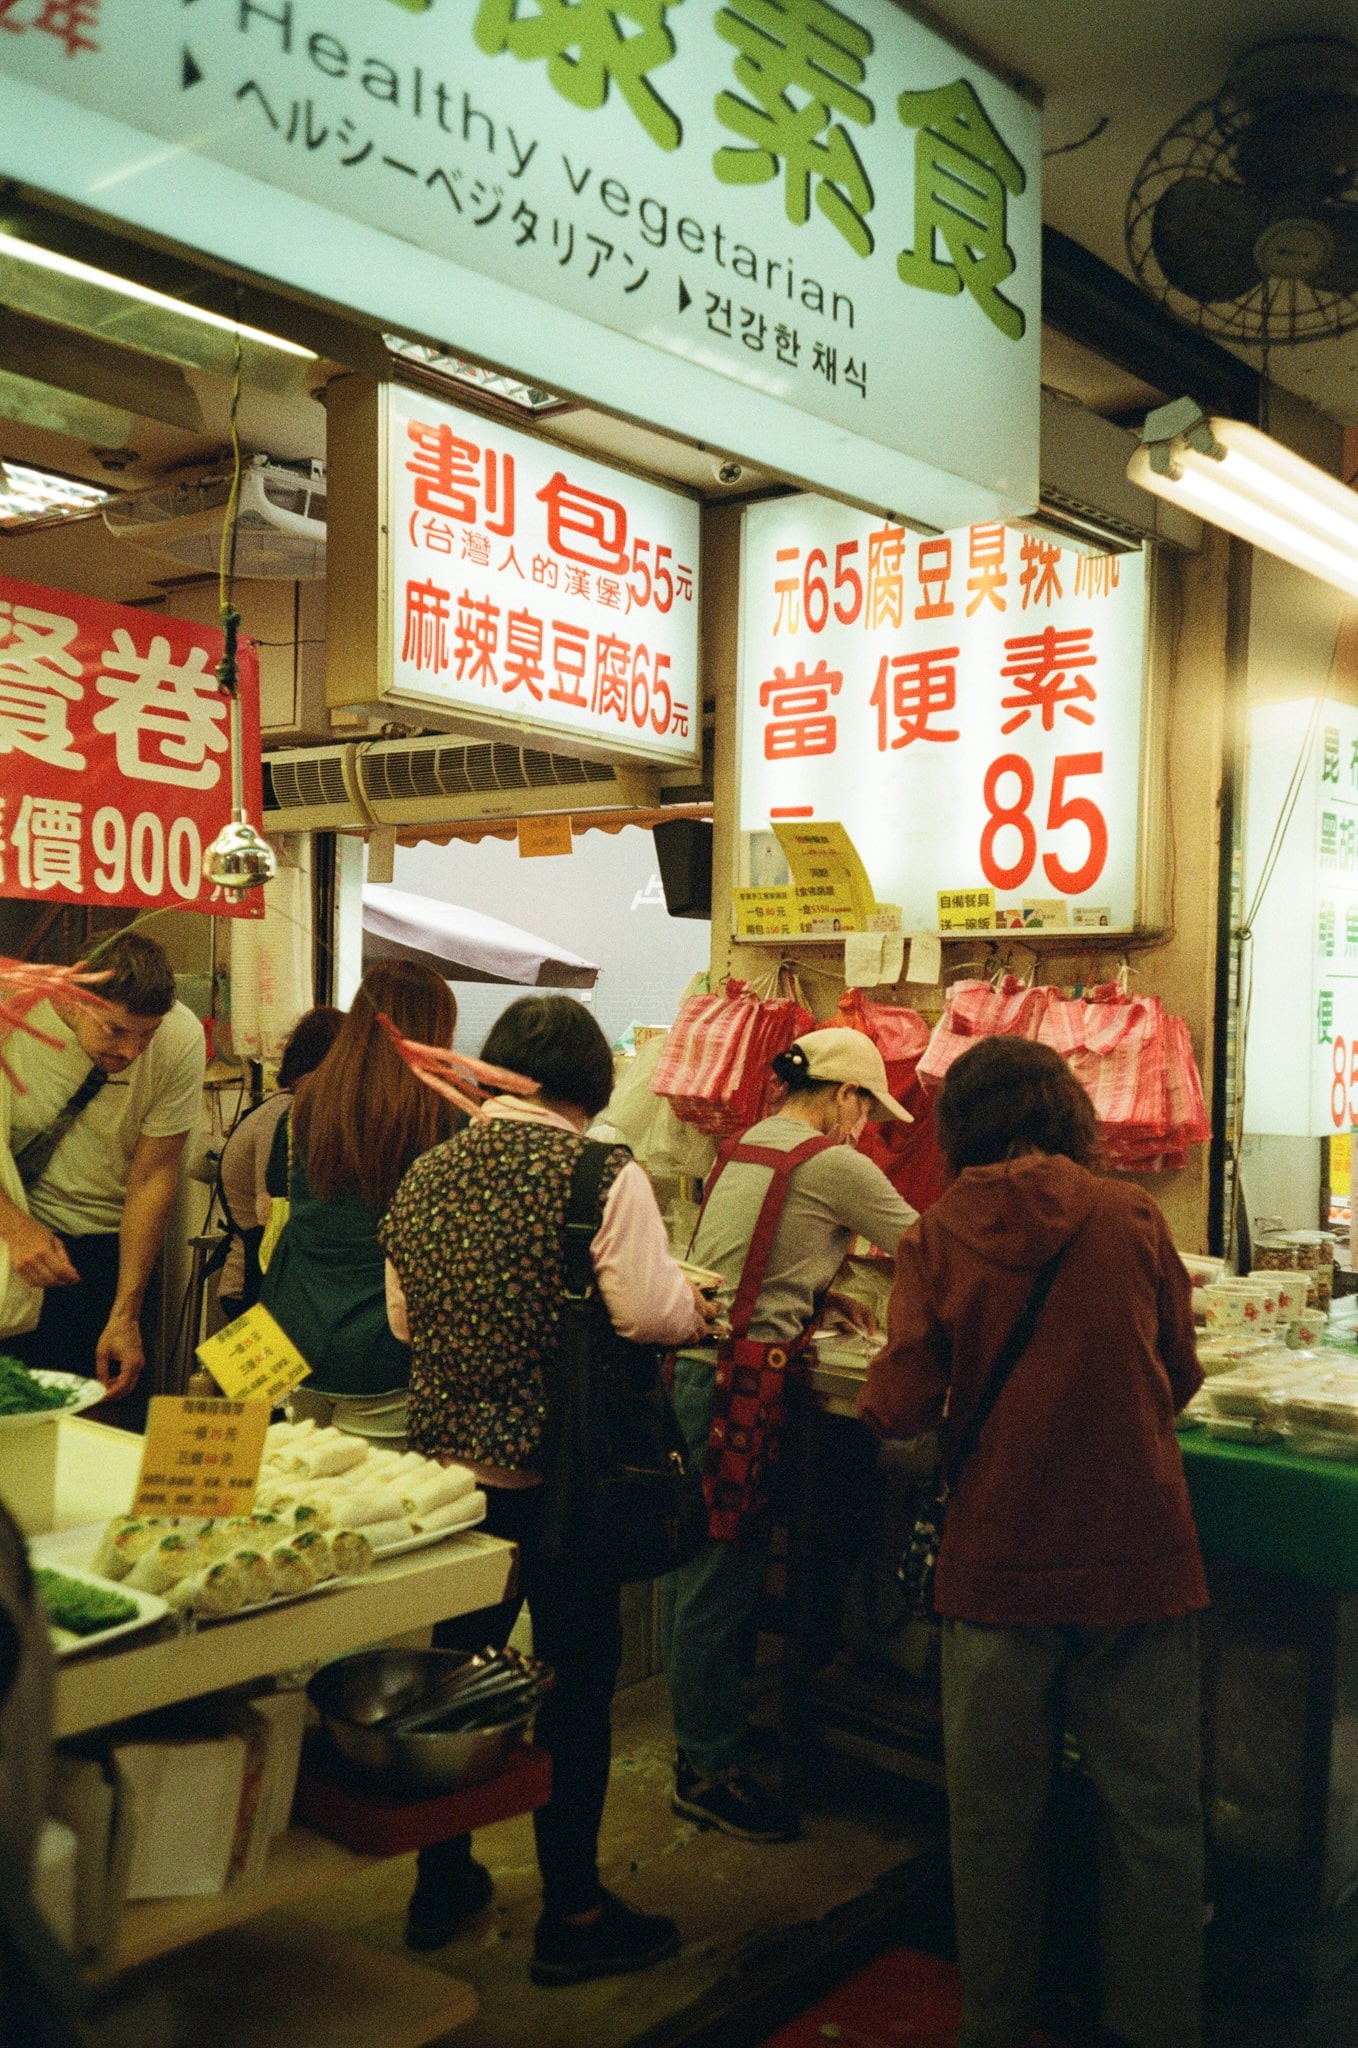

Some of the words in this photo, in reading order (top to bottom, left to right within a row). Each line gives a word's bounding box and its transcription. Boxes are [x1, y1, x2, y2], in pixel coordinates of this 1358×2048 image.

[236, 79, 650, 294] ヘルシーベジタリアン
[238, 0, 539, 178] Healthy
[562, 154, 856, 329] vegetarian
[704, 290, 800, 368] 건강한
[811, 342, 867, 400] 채식
[979, 750, 1108, 895] 85
[940, 893, 990, 910] 自備餐具
